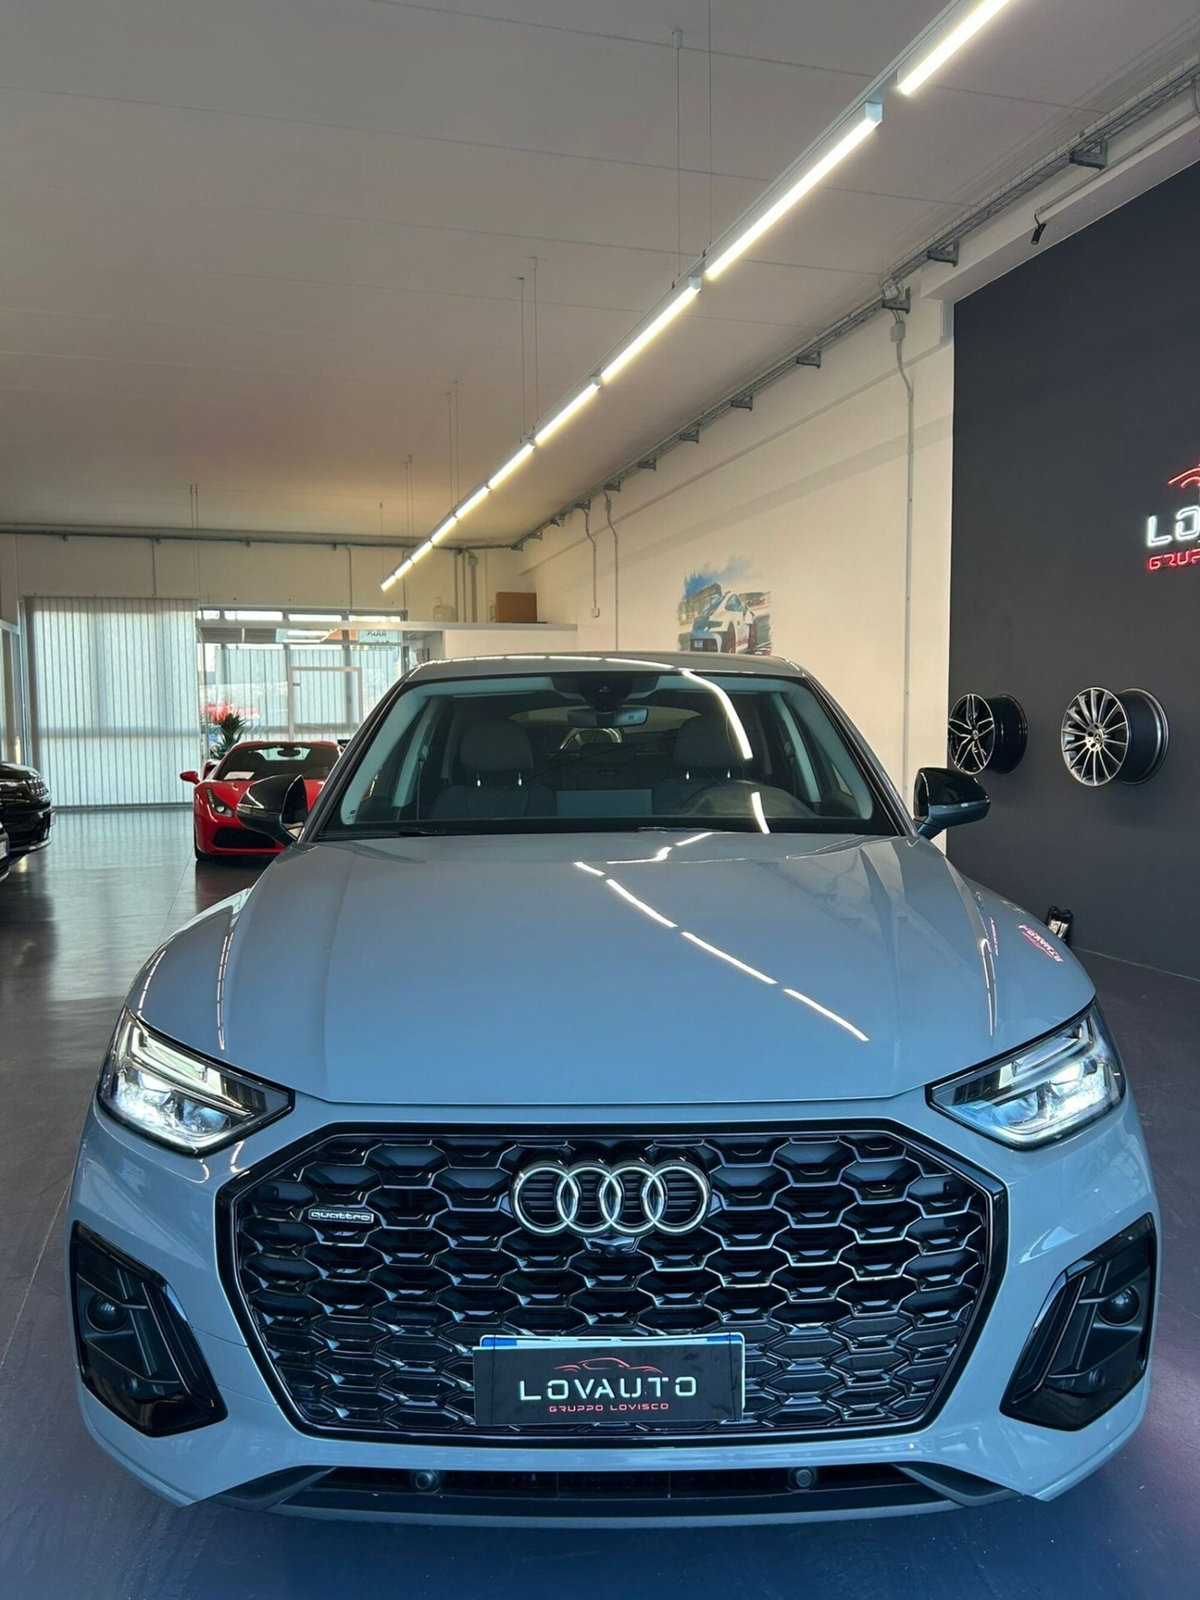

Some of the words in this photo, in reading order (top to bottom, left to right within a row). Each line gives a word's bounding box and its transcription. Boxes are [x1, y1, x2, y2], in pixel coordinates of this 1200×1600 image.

[310, 1211, 371, 1221] quattro
[519, 1376, 697, 1401] LOVAUTO
[549, 1403, 604, 1413] GRUPPO
[610, 1402, 669, 1412] LOVISCO
